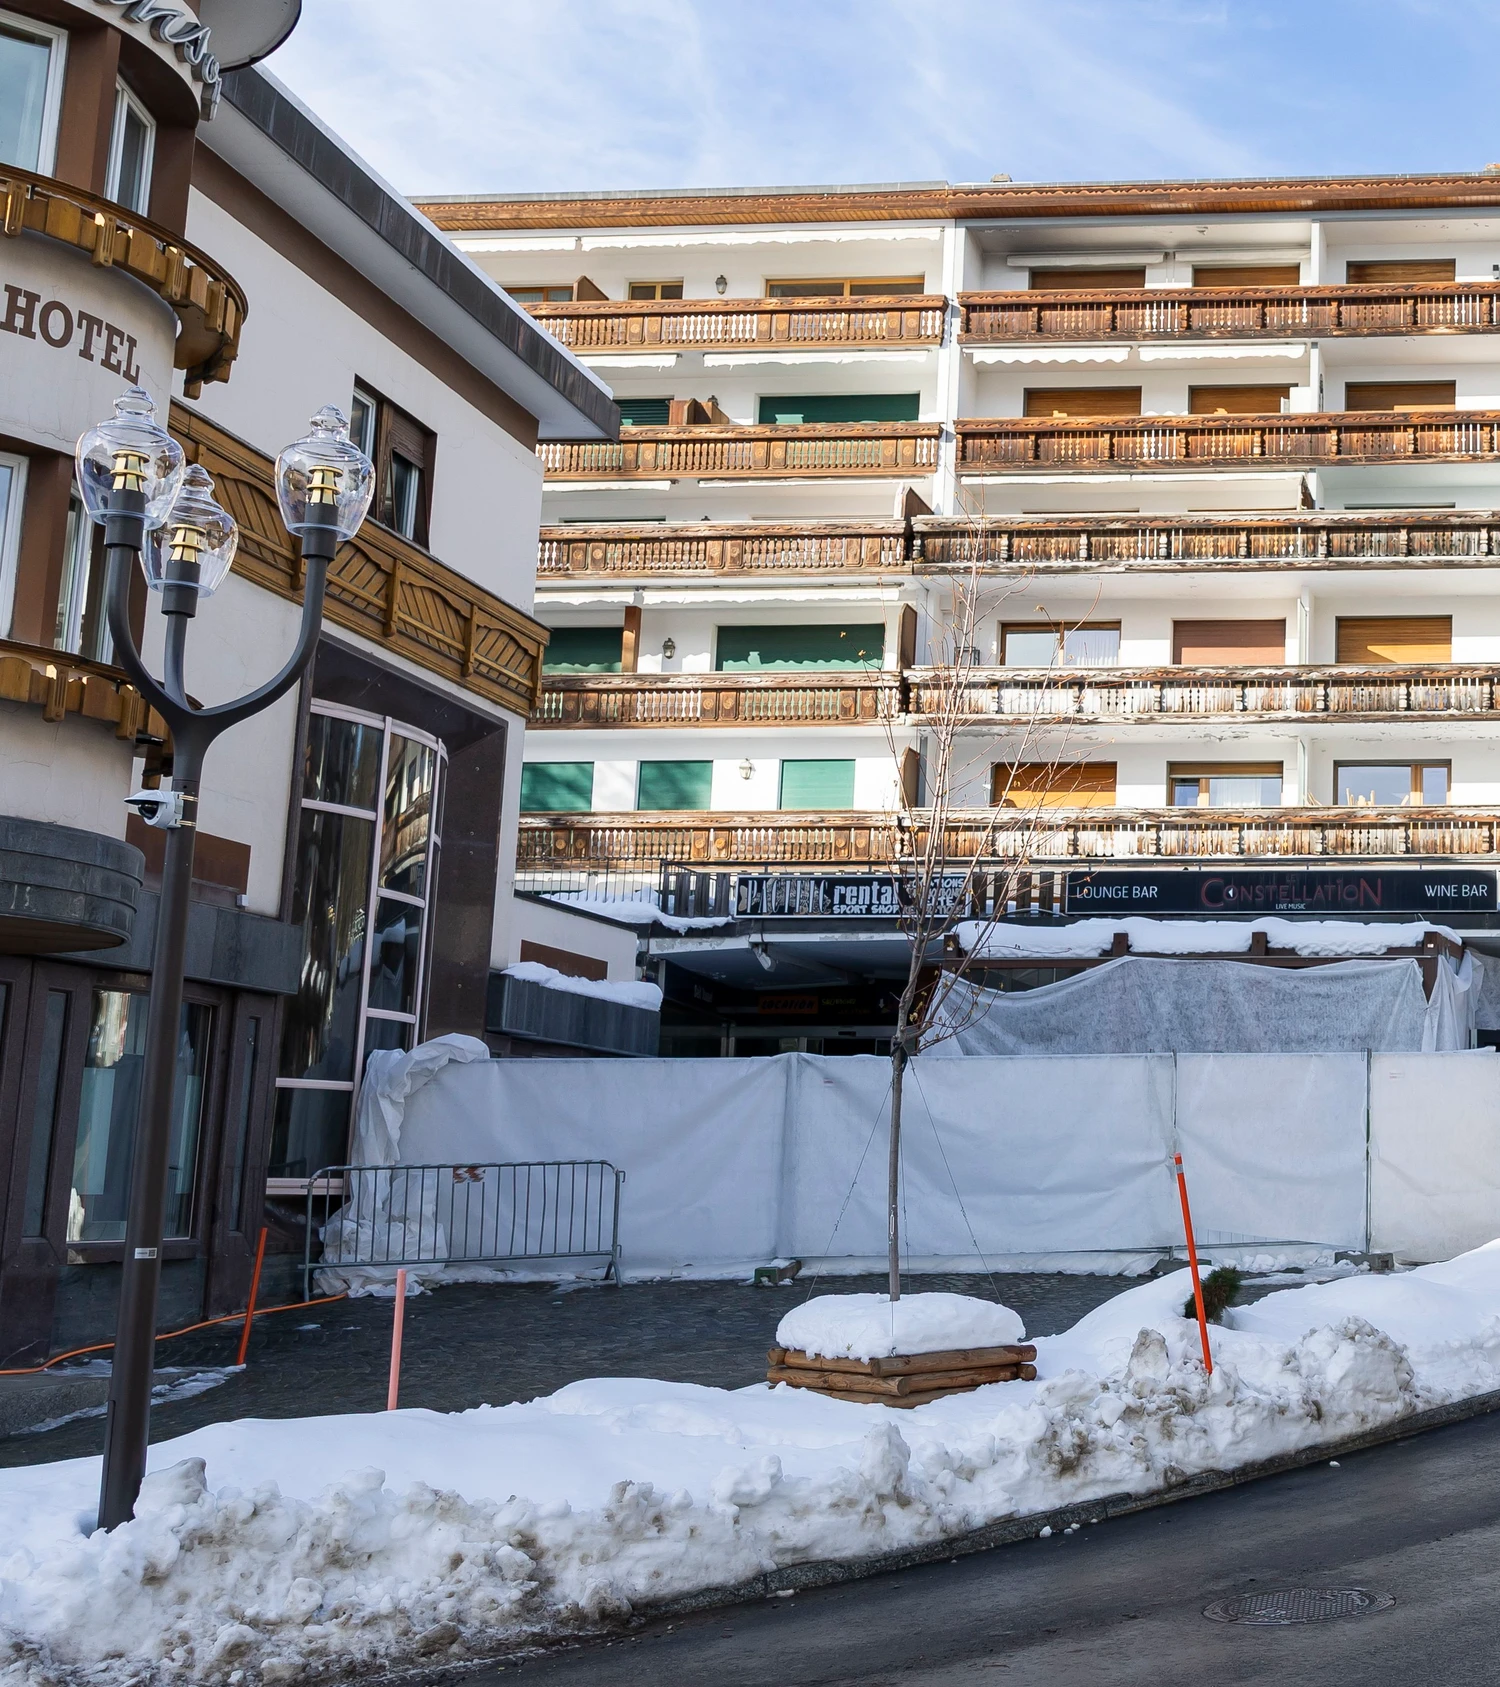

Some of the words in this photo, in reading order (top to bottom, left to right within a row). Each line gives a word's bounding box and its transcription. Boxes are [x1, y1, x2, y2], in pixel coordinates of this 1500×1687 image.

[0, 283, 140, 386] HOTEL
[746, 879, 829, 914] PACIFIC
[833, 880, 899, 905] rental
[1076, 885, 1129, 899] LOUNGE
[1132, 885, 1158, 899] BAR
[1424, 884, 1458, 898] WINE
[1461, 884, 1488, 898] BAR
[833, 904, 868, 915] SPORT
[871, 904, 899, 915] SHOP
